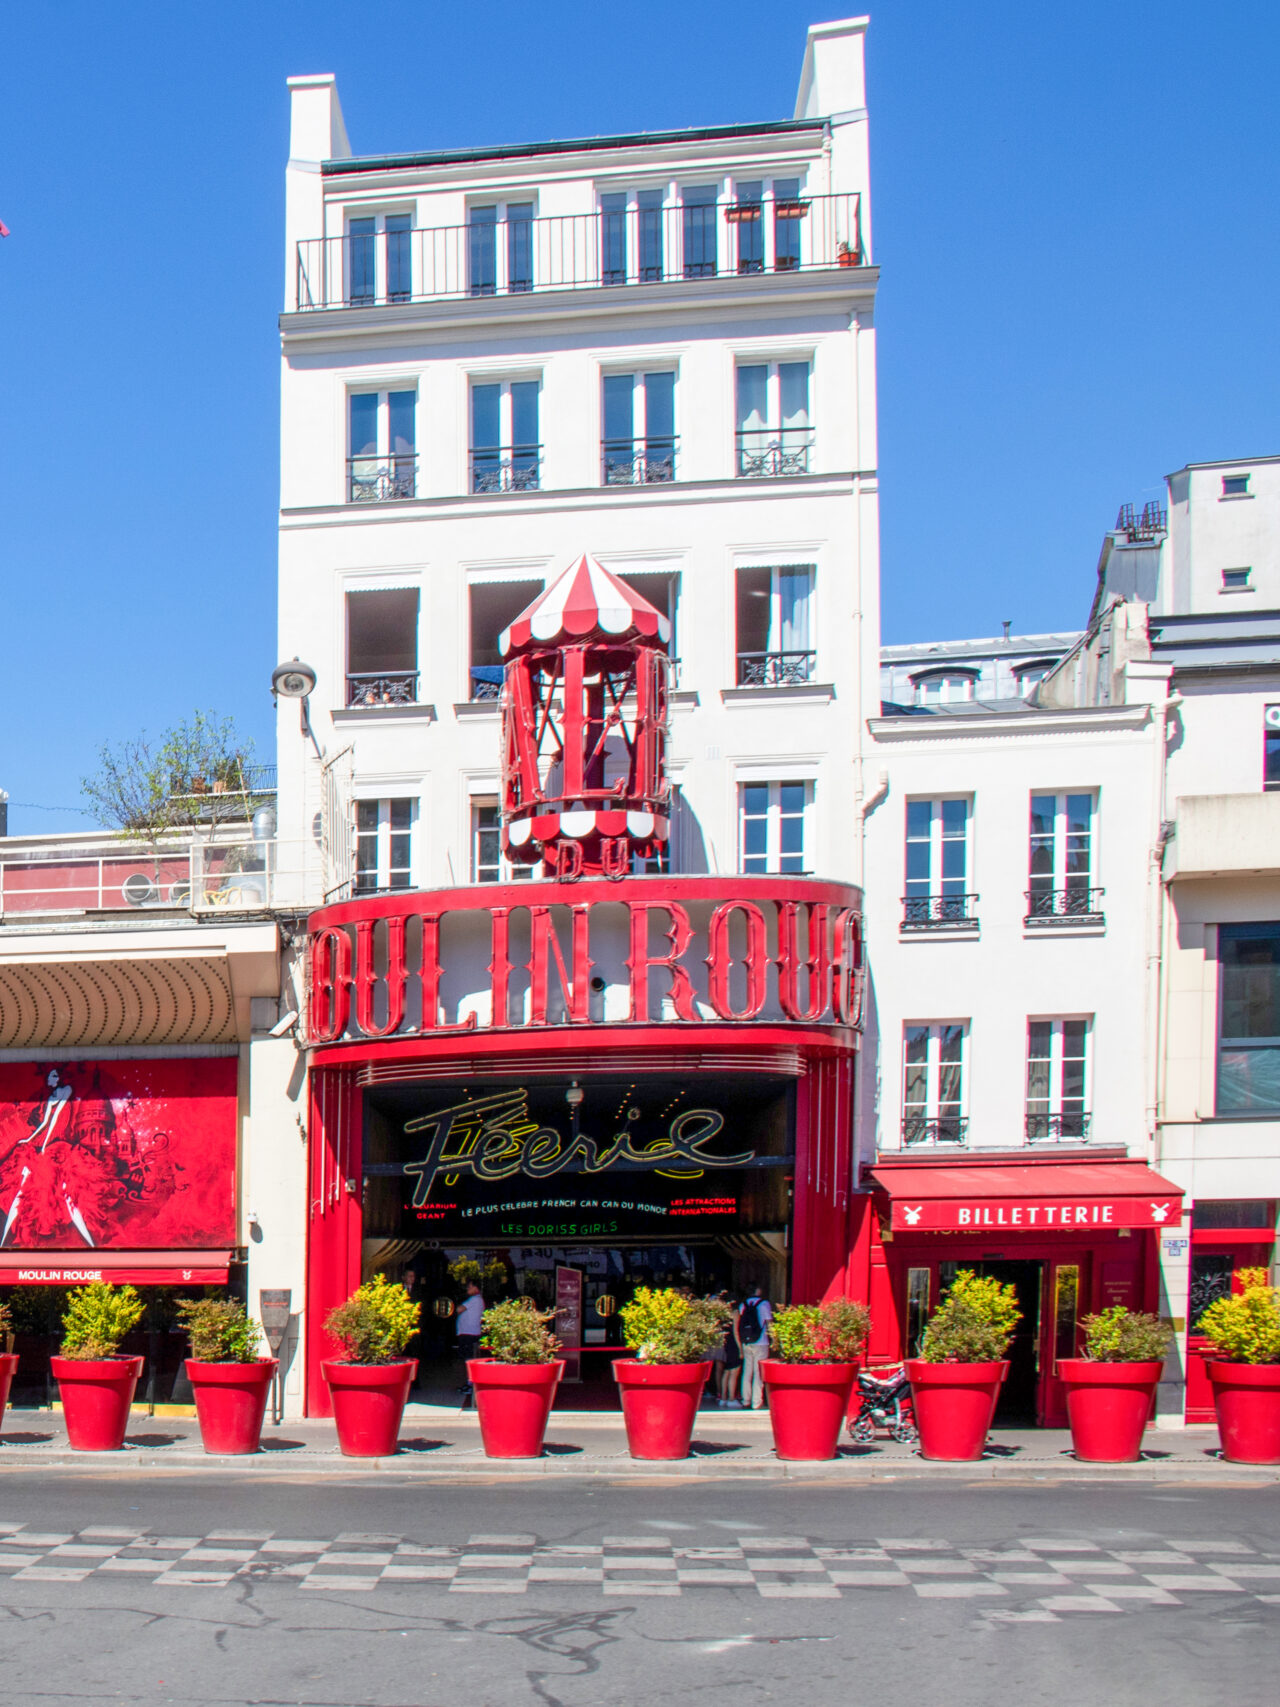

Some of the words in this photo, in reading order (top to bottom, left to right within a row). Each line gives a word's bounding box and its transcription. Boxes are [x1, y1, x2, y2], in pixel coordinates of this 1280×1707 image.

[556, 838, 629, 879] DU
[308, 902, 595, 1042] OULIN
[625, 899, 866, 1027] ROUG
[461, 1209, 473, 1218] LE
[475, 1205, 498, 1215] PLUS
[637, 1203, 668, 1215] MONDE
[669, 1207, 737, 1216] INTERNATIONALES
[958, 1206, 1113, 1225] BILLETTERIE
[501, 1224, 523, 1234] LES
[528, 1224, 577, 1235] DORISS
[580, 1221, 618, 1235] GIRLS
[19, 1270, 61, 1280] MOULIN
[63, 1271, 102, 1281] ROUGE
